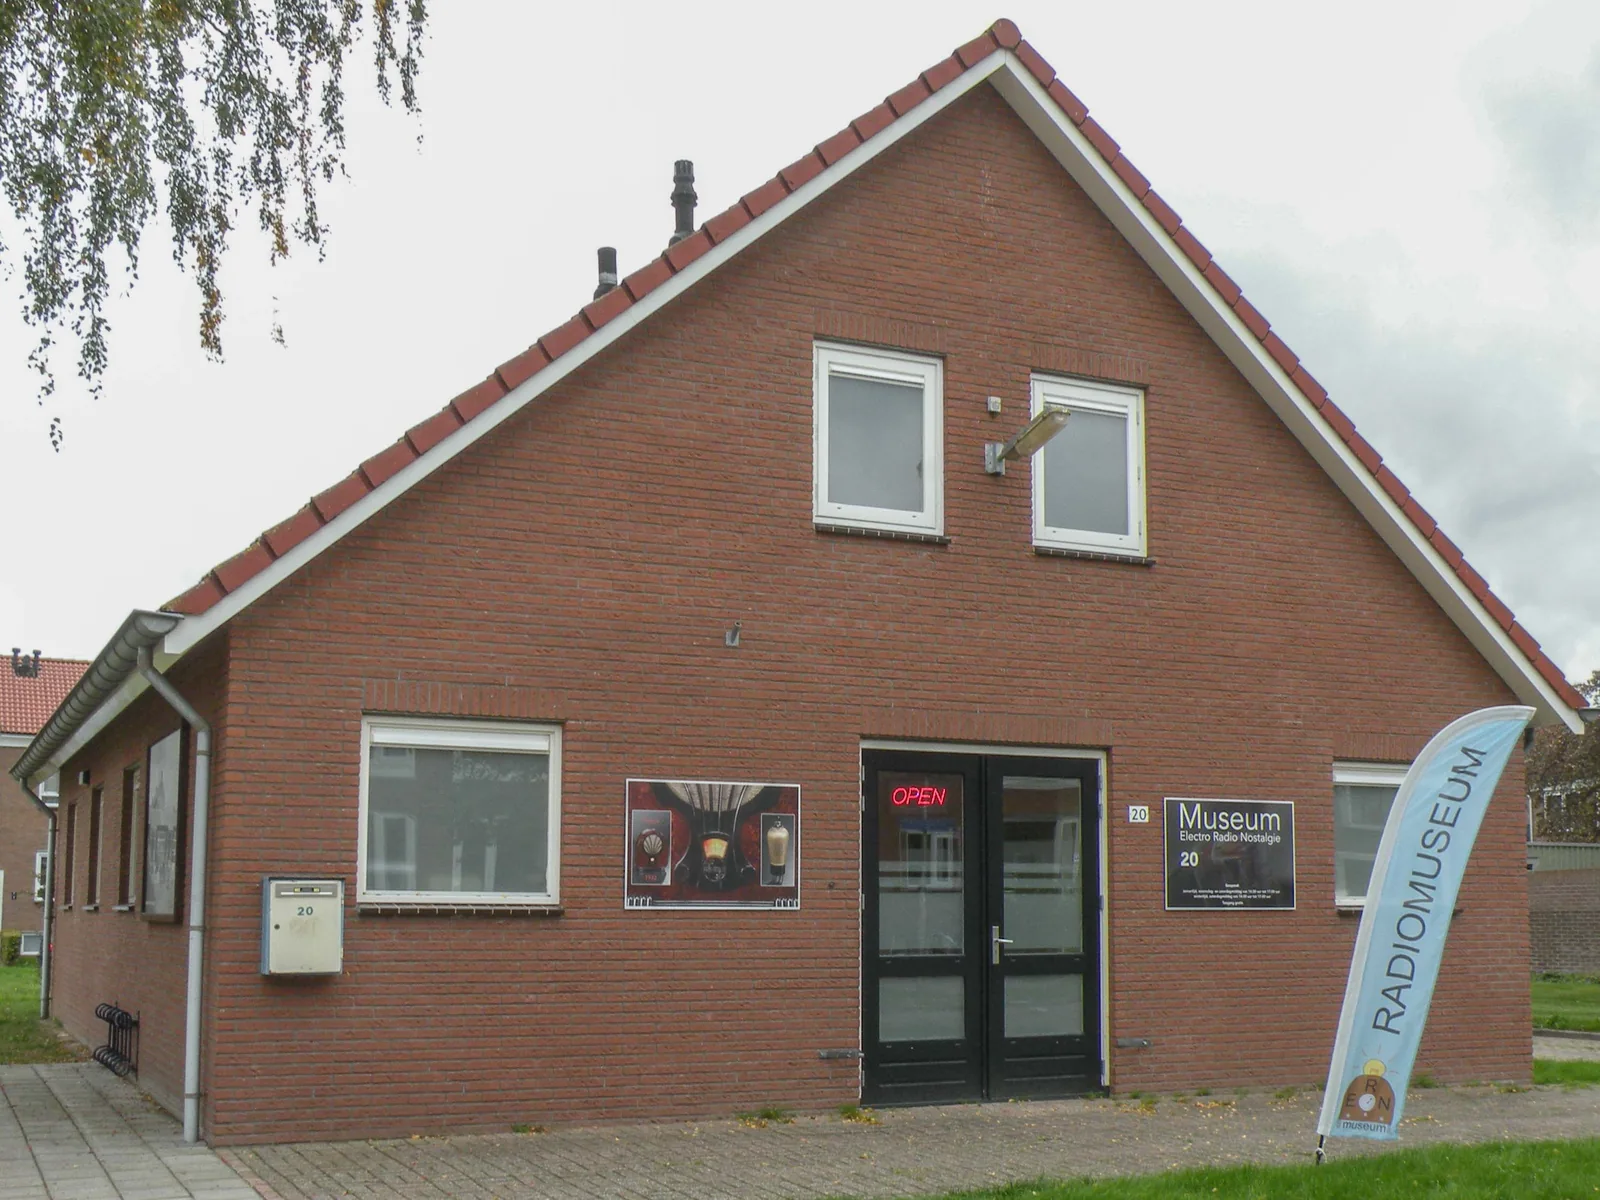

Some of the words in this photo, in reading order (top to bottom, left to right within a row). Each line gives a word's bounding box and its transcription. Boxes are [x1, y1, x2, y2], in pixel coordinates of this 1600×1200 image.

[892, 787, 946, 806] OPEN
[1131, 808, 1147, 821] 20
[1179, 802, 1281, 831] Museum
[1180, 830, 1211, 842] Electro
[1213, 831, 1239, 843] Radio
[1240, 832, 1281, 846] Nostalgie
[1180, 851, 1199, 867] 20
[1372, 746, 1487, 1035] RADIOMUSEUM
[297, 906, 314, 916] 20
[1342, 1121, 1386, 1132] museum
